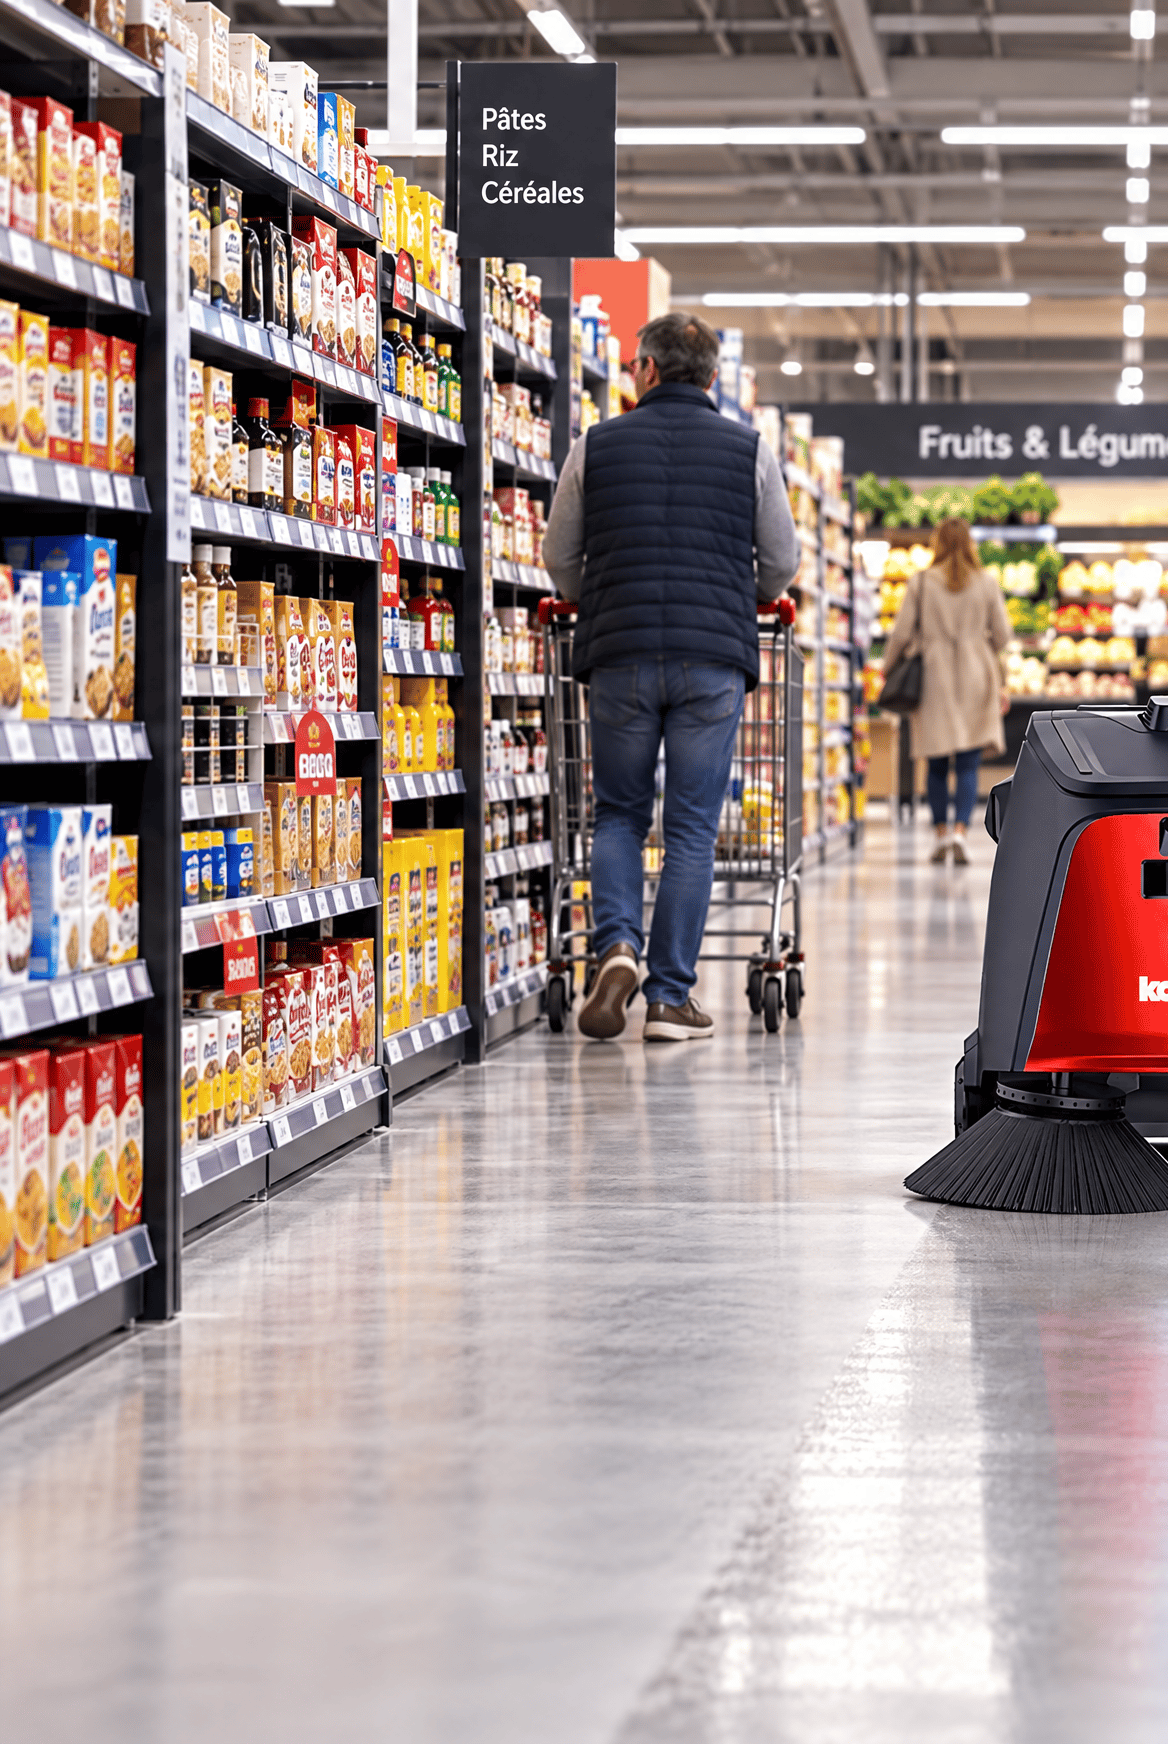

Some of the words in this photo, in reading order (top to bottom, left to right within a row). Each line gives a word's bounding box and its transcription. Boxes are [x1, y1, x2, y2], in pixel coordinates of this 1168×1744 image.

[481, 106, 547, 131] Pâtes
[481, 143, 519, 167] Riz
[481, 180, 585, 205] Céréales
[918, 424, 1013, 460] Fruits
[1021, 424, 1050, 460] &
